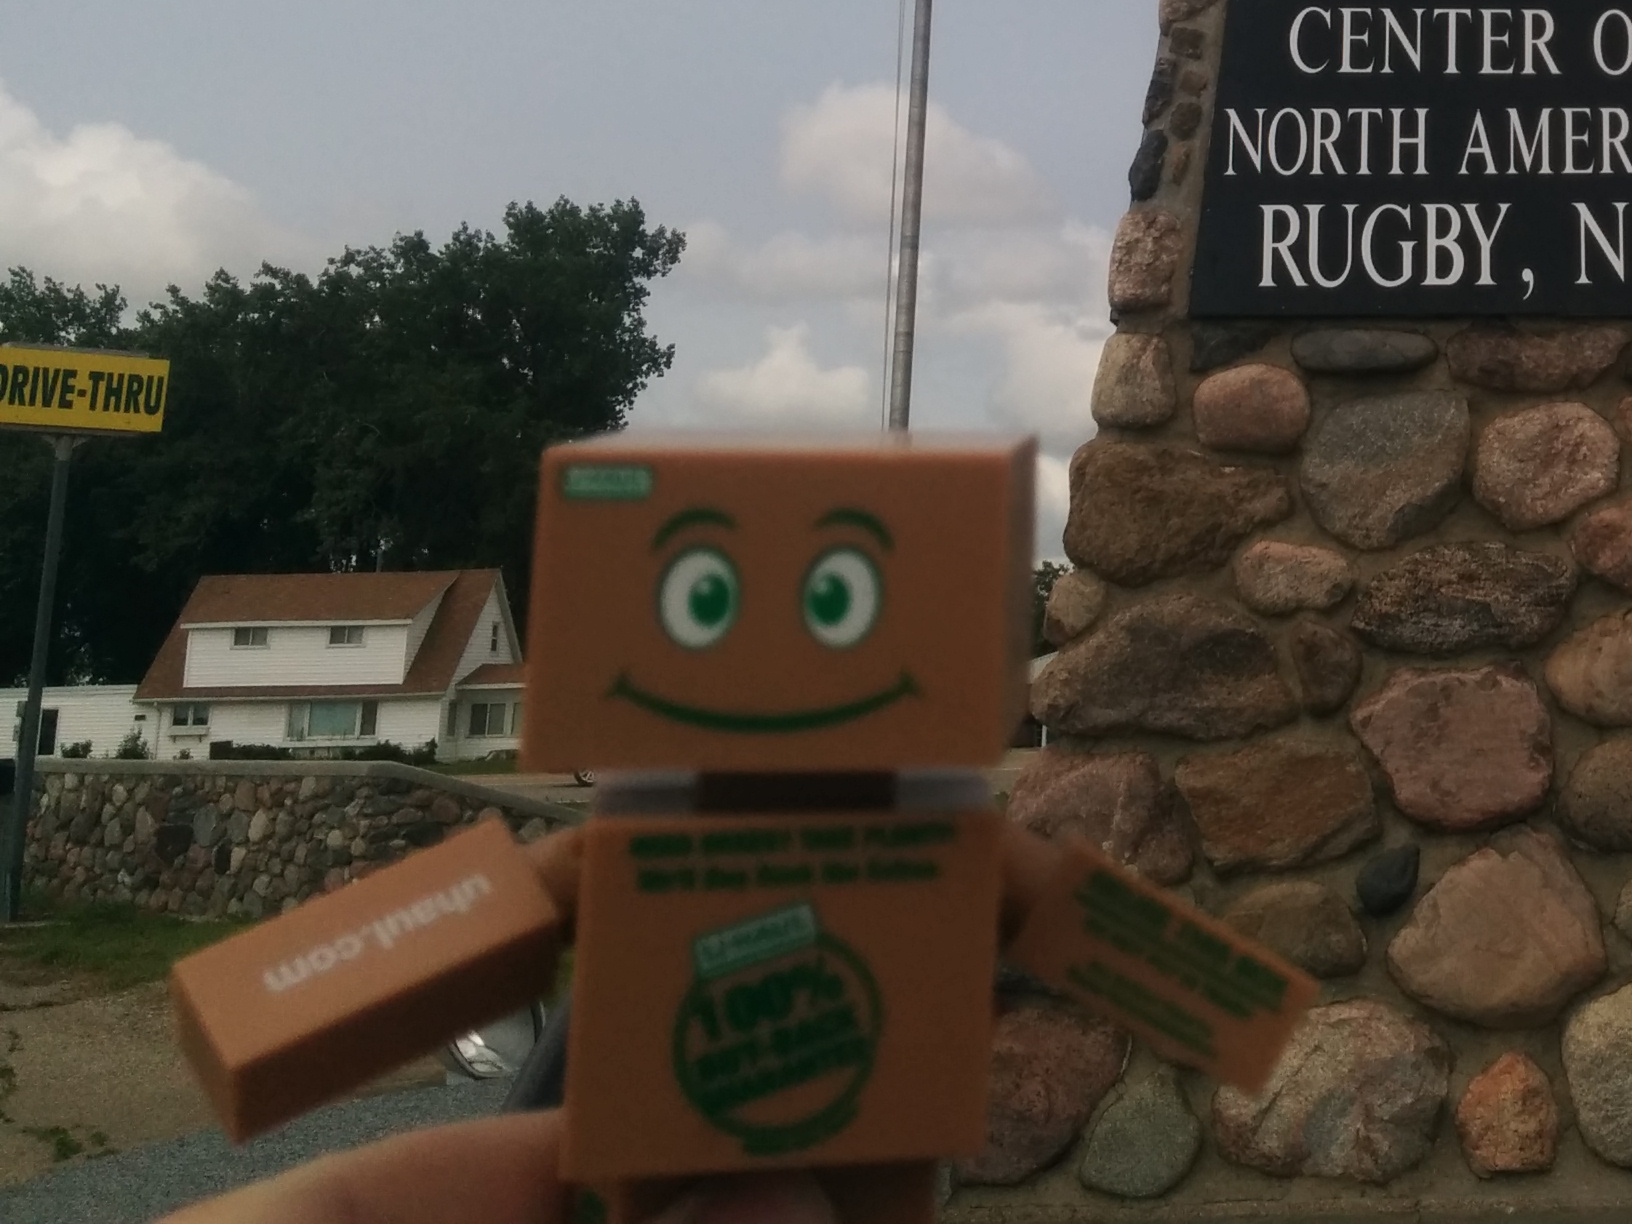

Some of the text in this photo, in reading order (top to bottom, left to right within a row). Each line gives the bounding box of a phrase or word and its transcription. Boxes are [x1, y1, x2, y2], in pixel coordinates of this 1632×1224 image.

[1289, 6, 1562, 75] CENTER
[1223, 107, 1430, 176] NORTH
[1258, 202, 1535, 300] RUGBY,
